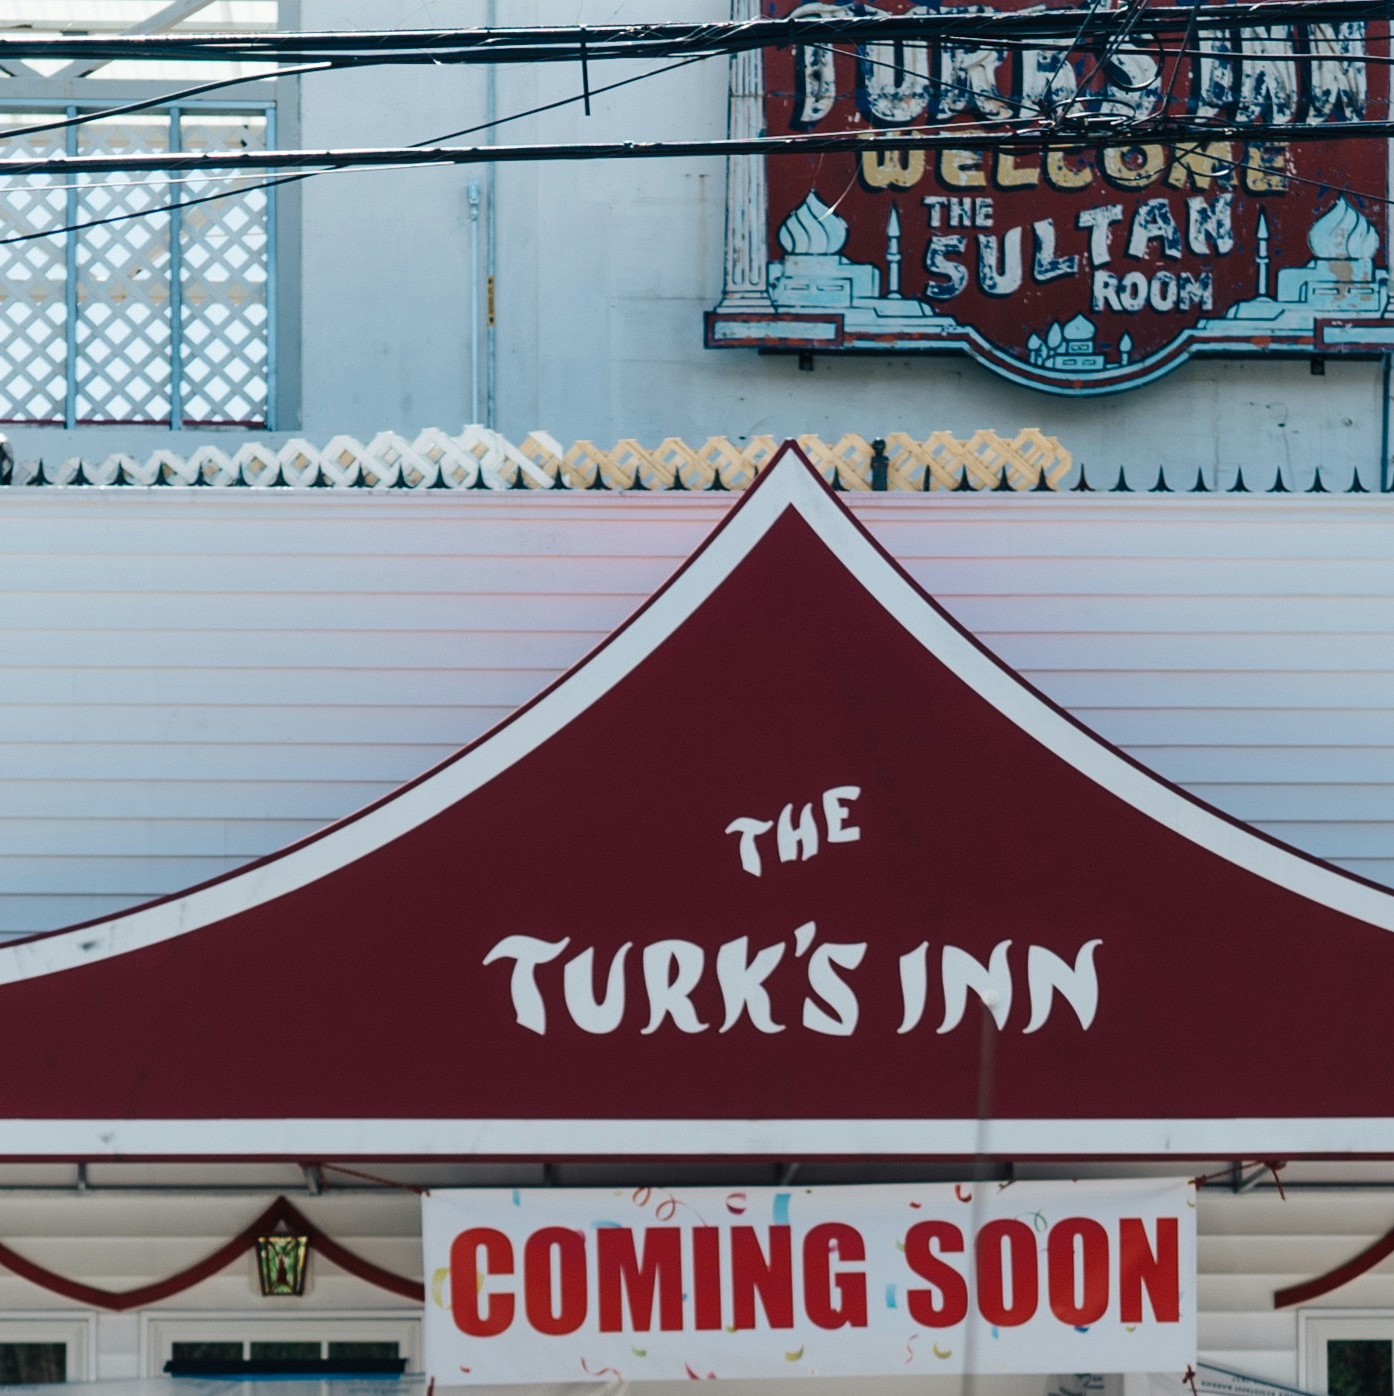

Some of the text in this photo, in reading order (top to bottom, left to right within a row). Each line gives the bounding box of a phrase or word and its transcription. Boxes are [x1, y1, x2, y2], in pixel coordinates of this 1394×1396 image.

[856, 130, 1292, 192] WELCOME
[924, 196, 994, 229] THE
[924, 194, 1236, 299] SULTAN
[1092, 271, 1214, 313] ROOM
[725, 786, 861, 877] THE
[482, 921, 1103, 1036] TURK'S INN
[449, 1216, 1181, 1337] COMING SOON
